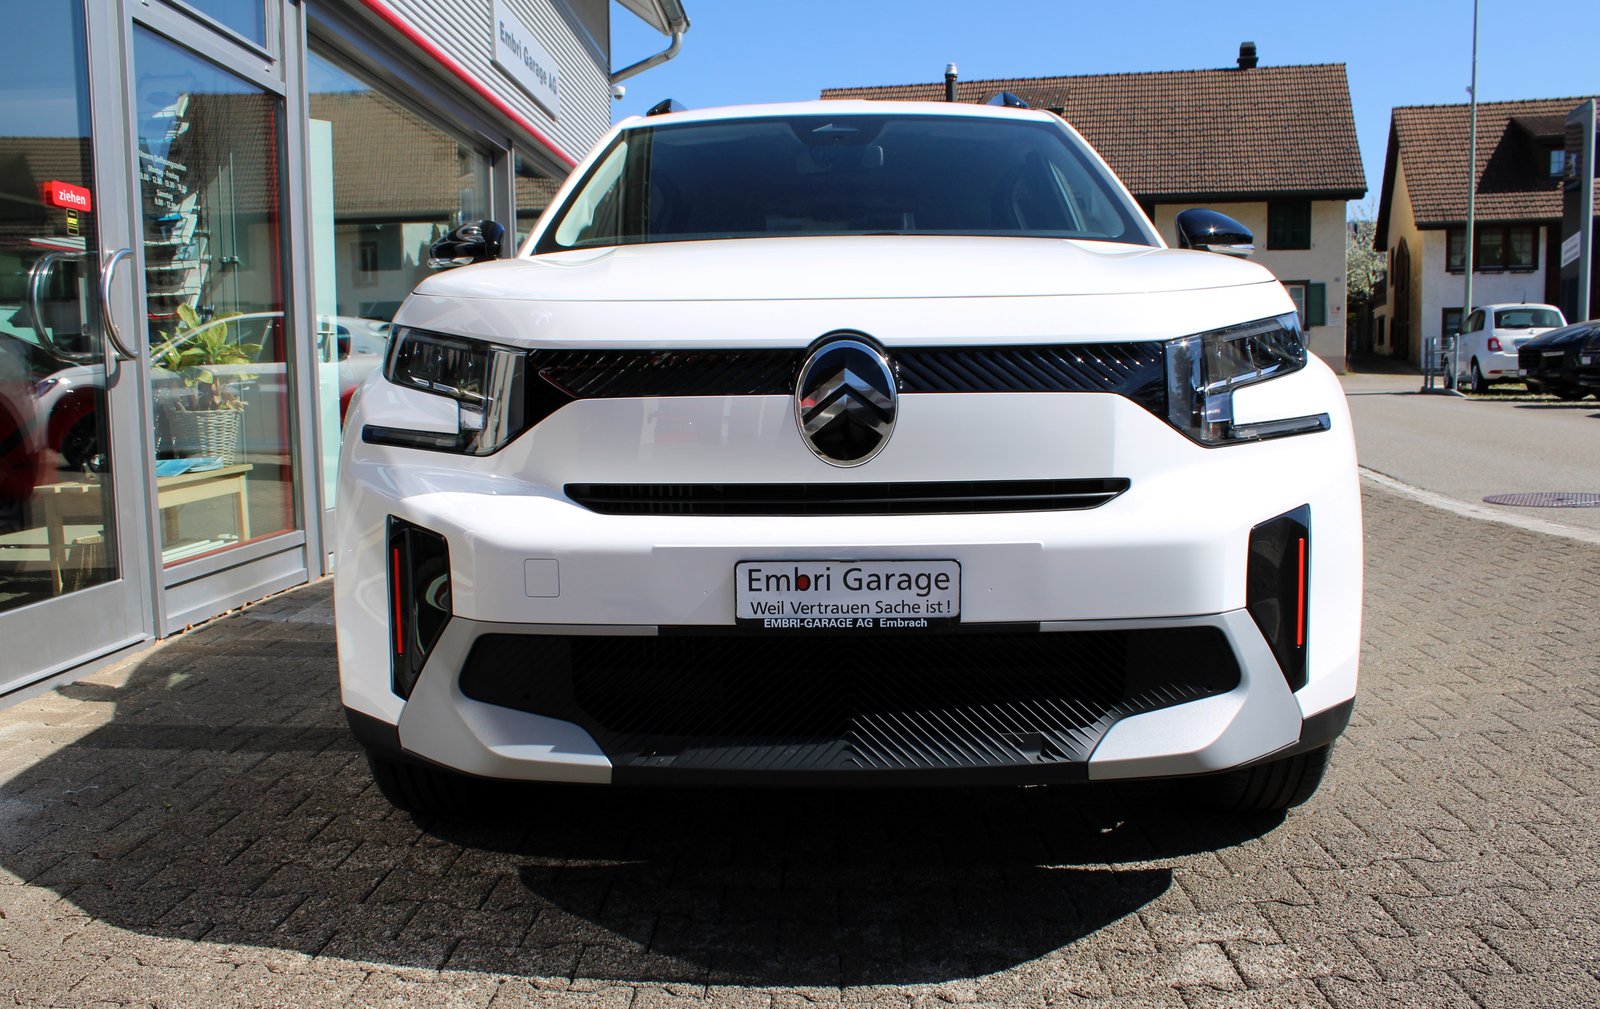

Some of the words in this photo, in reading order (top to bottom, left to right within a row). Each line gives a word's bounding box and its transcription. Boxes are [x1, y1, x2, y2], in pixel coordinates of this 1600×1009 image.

[500, 20, 522, 60] Embri
[524, 46, 547, 86] Garage
[548, 73, 557, 95] AG
[58, 190, 86, 205] ziehen
[748, 566, 831, 592] Embri
[842, 568, 950, 596] Garage
[750, 600, 784, 614] Weil
[790, 601, 870, 614] Vertrauen
[876, 600, 920, 614] Sache
[764, 618, 853, 628] EMBRI-GARAGE
[856, 618, 873, 628] AG
[880, 618, 928, 628] Embrach
